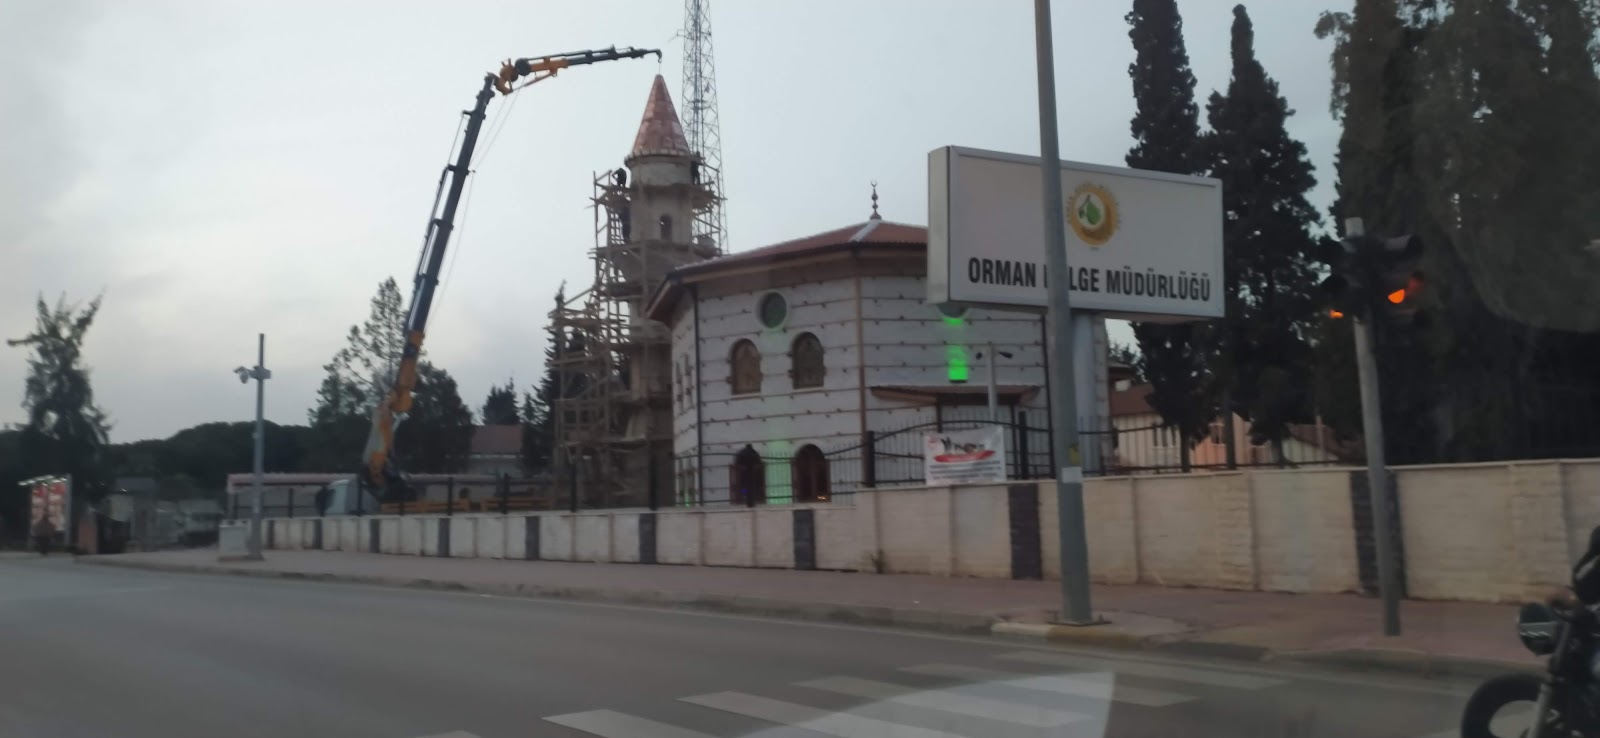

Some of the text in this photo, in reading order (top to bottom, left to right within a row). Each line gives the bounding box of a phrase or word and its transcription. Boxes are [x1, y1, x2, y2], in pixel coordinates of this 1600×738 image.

[968, 257, 1211, 301] ORMAN LGE MÜDÜRLÜĞÜ
